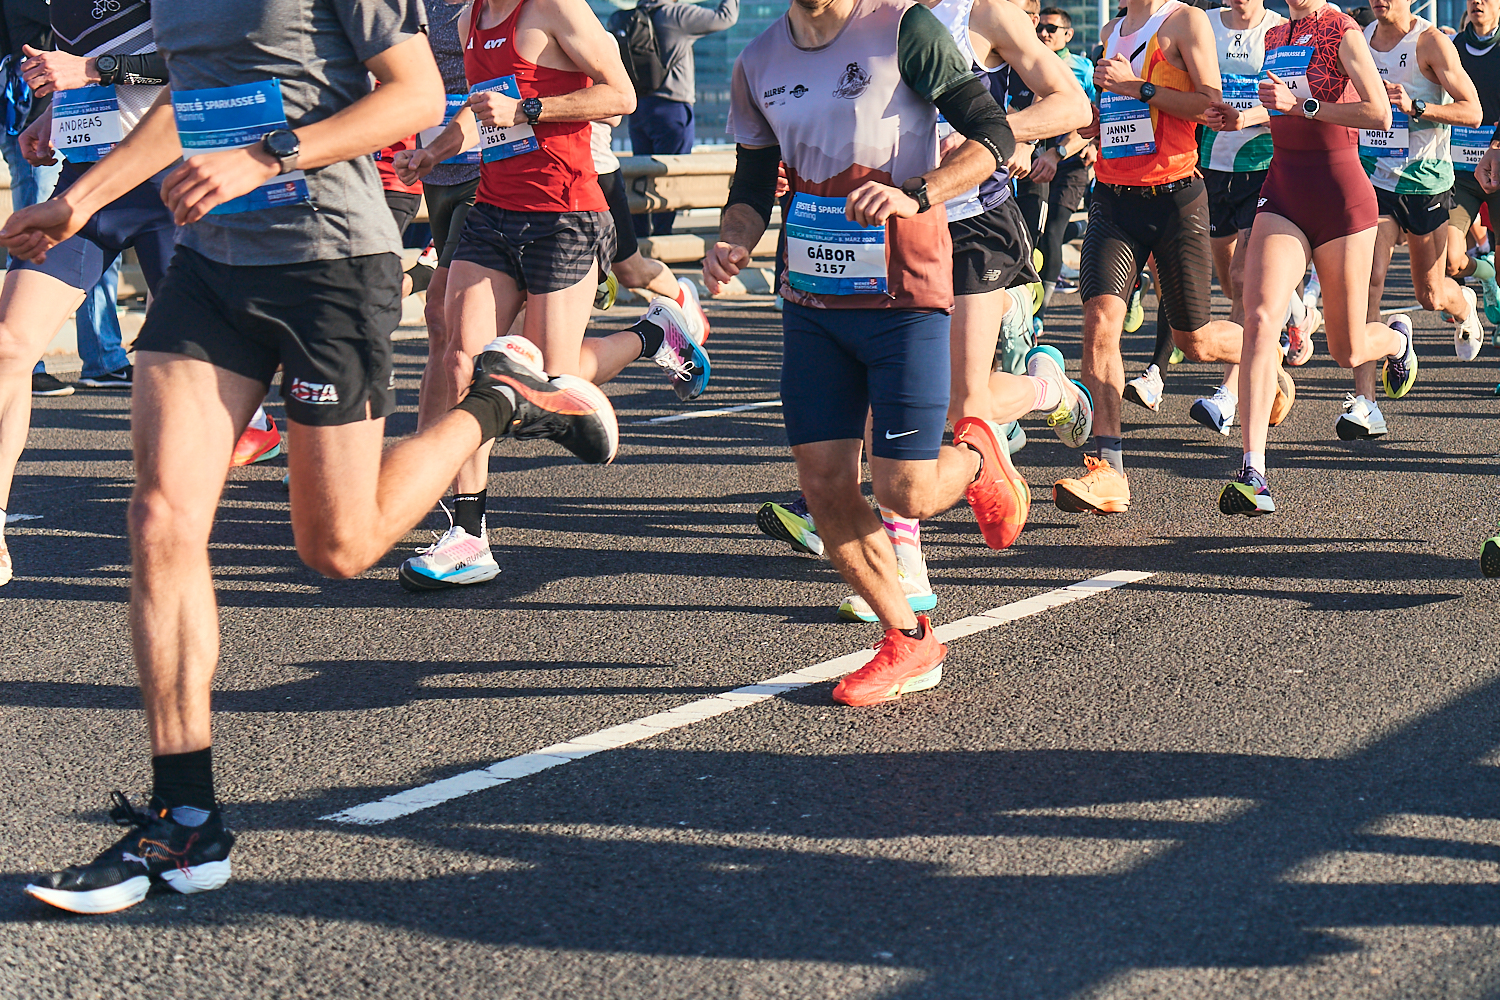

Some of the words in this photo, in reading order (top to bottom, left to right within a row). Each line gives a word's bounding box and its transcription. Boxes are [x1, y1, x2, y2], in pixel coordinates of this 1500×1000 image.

[175, 102, 195, 112] ERSTE
[204, 96, 254, 110] SPARKASSE
[178, 112, 205, 122] Running
[59, 116, 102, 133] ANDREAS
[1107, 124, 1136, 135] JANNIS
[66, 134, 91, 144] 3476
[487, 133, 506, 144] 2618
[1111, 135, 1129, 143] 2617
[1365, 130, 1394, 139] MORITZ
[796, 201, 811, 211] ERSTE
[794, 208, 816, 221] Running
[807, 244, 856, 262] GÁBOR
[815, 263, 846, 274] 3157
